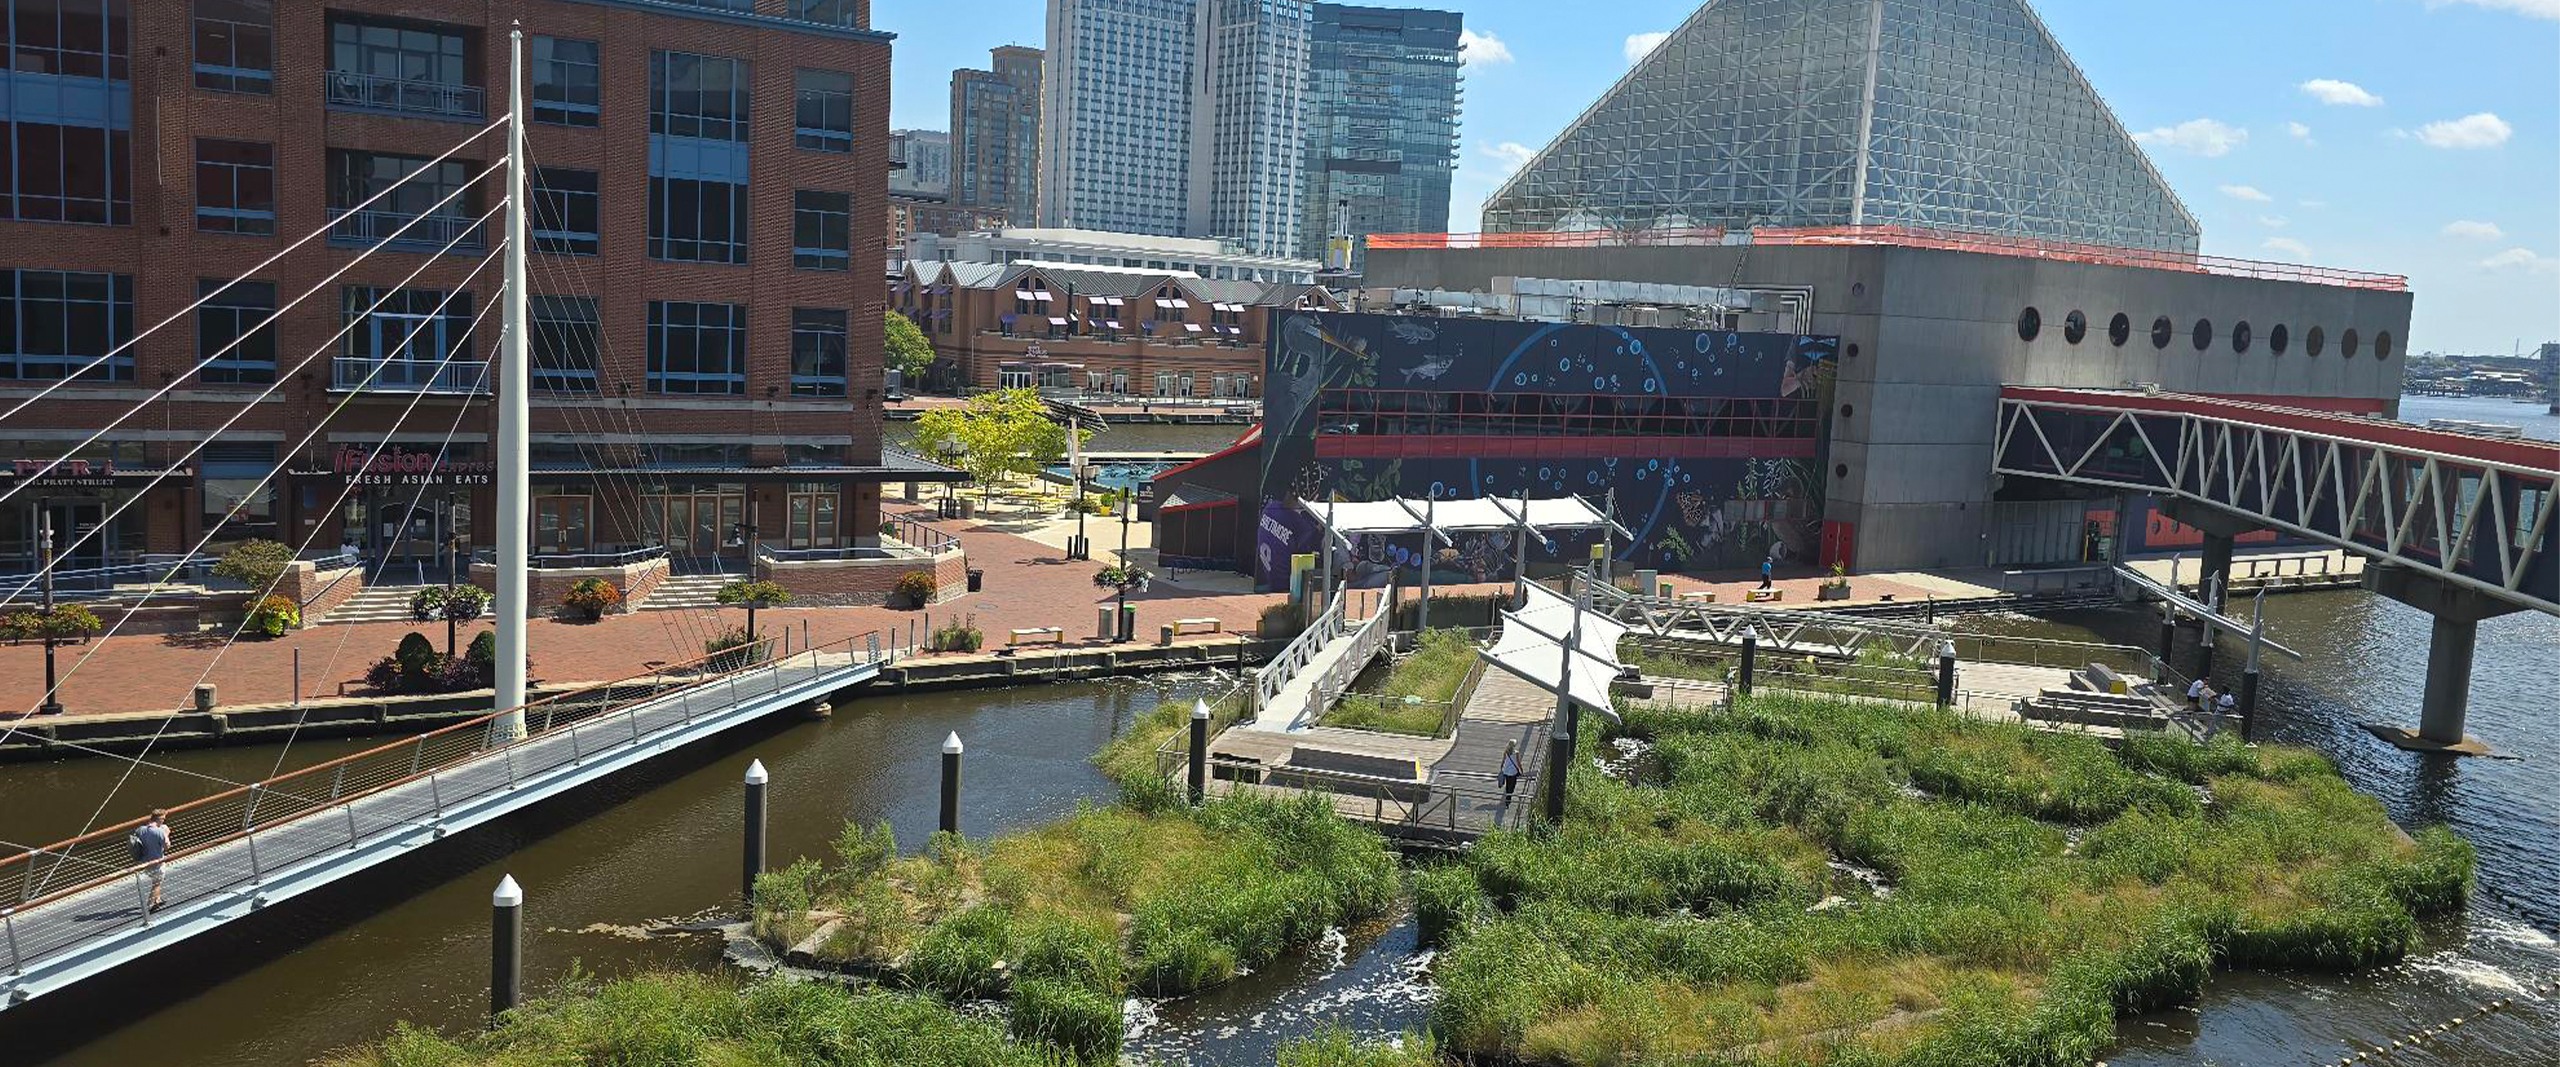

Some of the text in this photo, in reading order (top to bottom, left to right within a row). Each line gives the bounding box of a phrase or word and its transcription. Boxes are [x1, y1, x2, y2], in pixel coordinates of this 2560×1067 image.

[345, 475, 489, 485] FRESH ASIAN EATS
[1260, 513, 1293, 546] BALTIMORE
